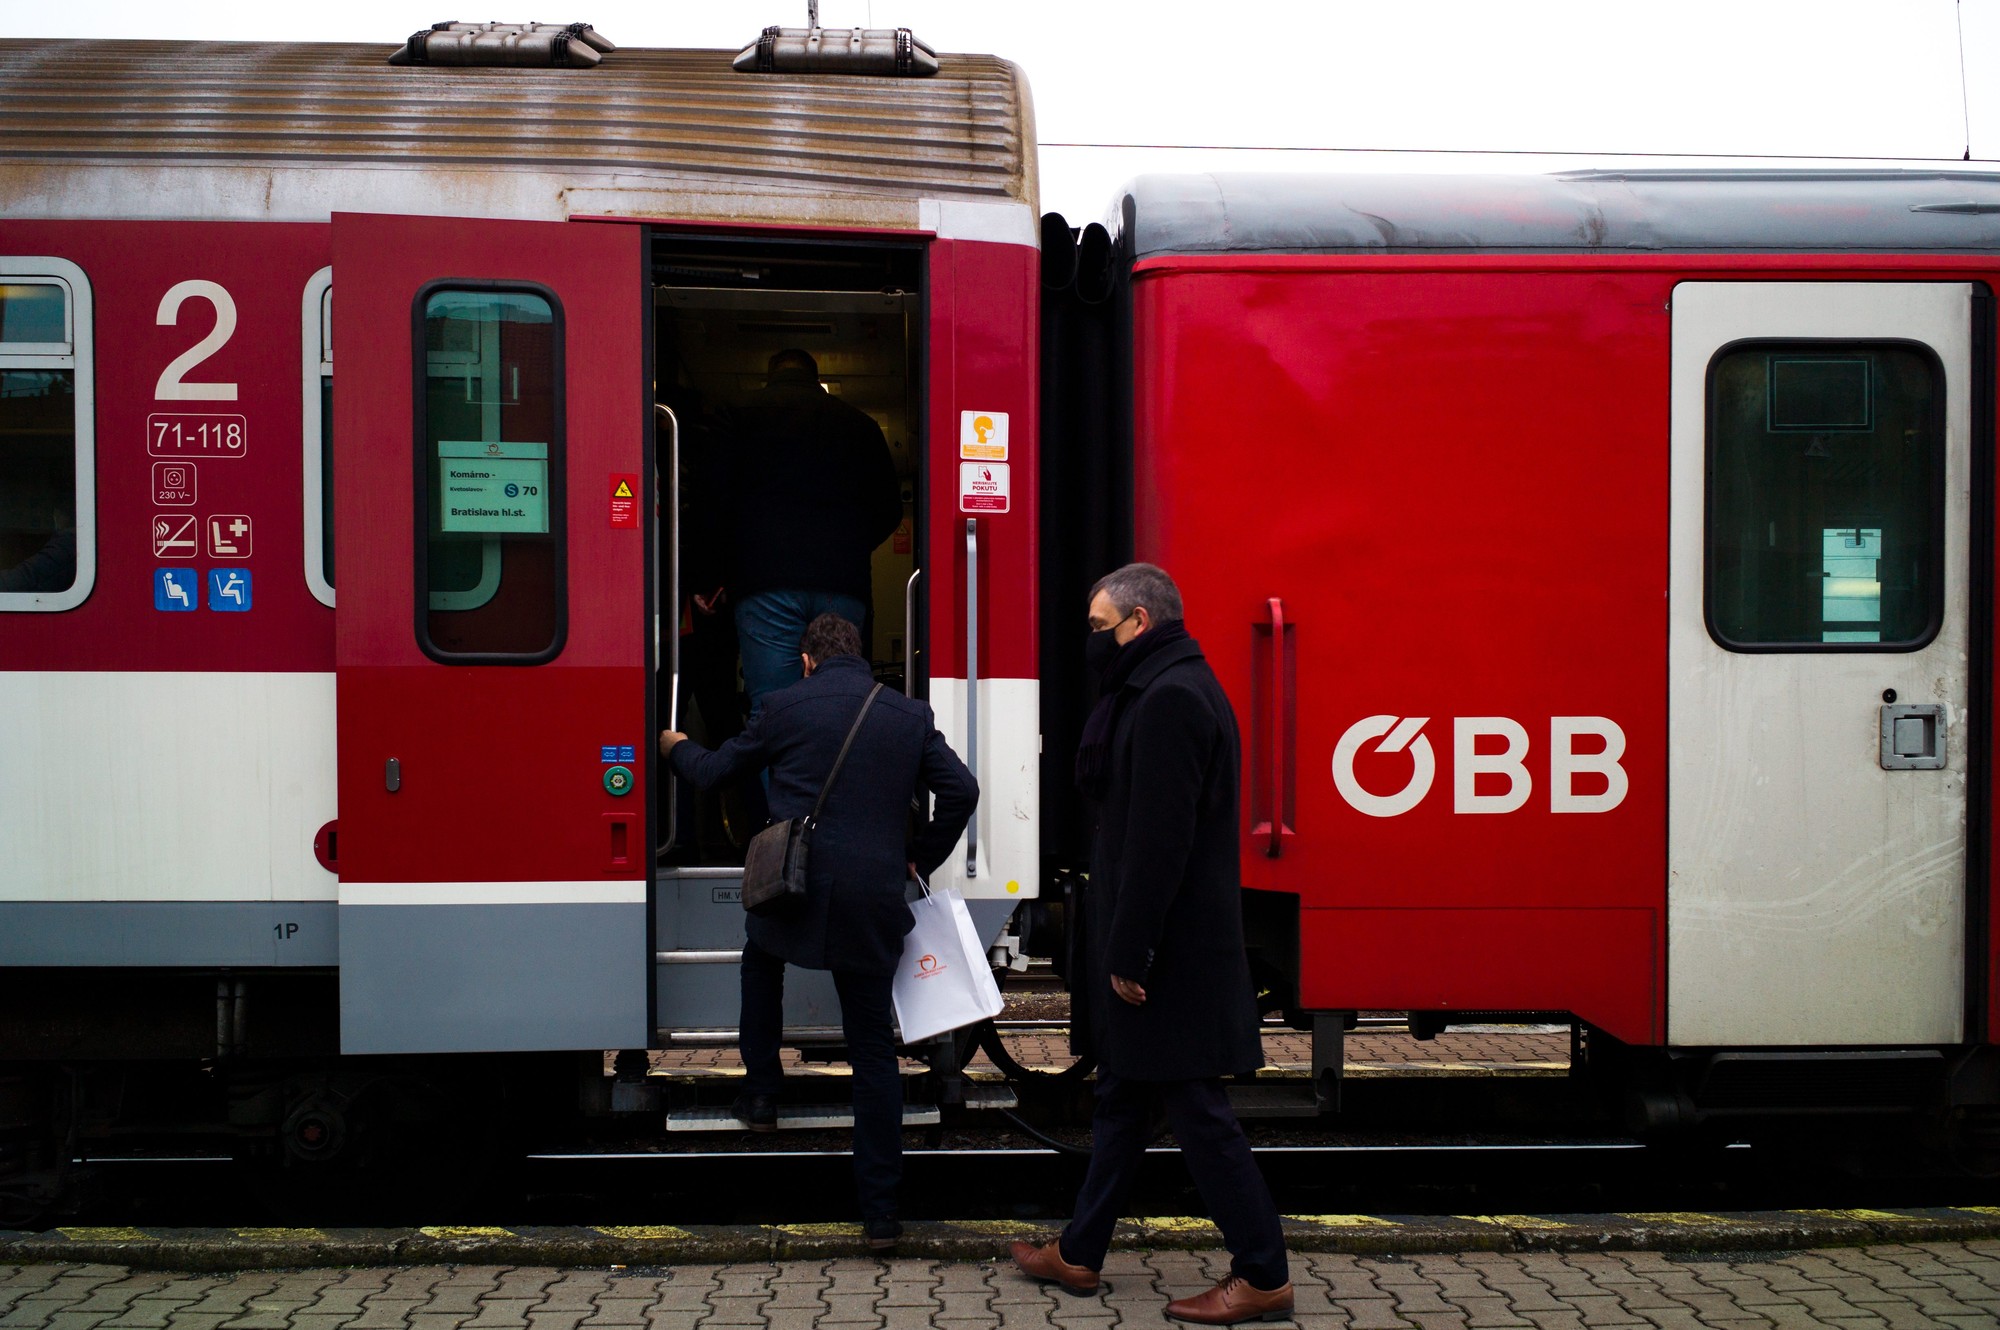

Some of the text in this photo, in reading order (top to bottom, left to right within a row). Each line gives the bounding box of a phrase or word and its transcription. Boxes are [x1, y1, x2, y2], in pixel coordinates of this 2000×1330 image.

[154, 279, 238, 401] 2
[153, 422, 242, 449] 71-118
[450, 470, 490, 479] Komárno
[160, 491, 176, 499] 230
[523, 486, 538, 496] 70
[451, 508, 526, 517] Bratislava hl.st.
[1332, 714, 1629, 818] ÖBB
[717, 891, 733, 900] HM.
[273, 922, 299, 939] 1P
